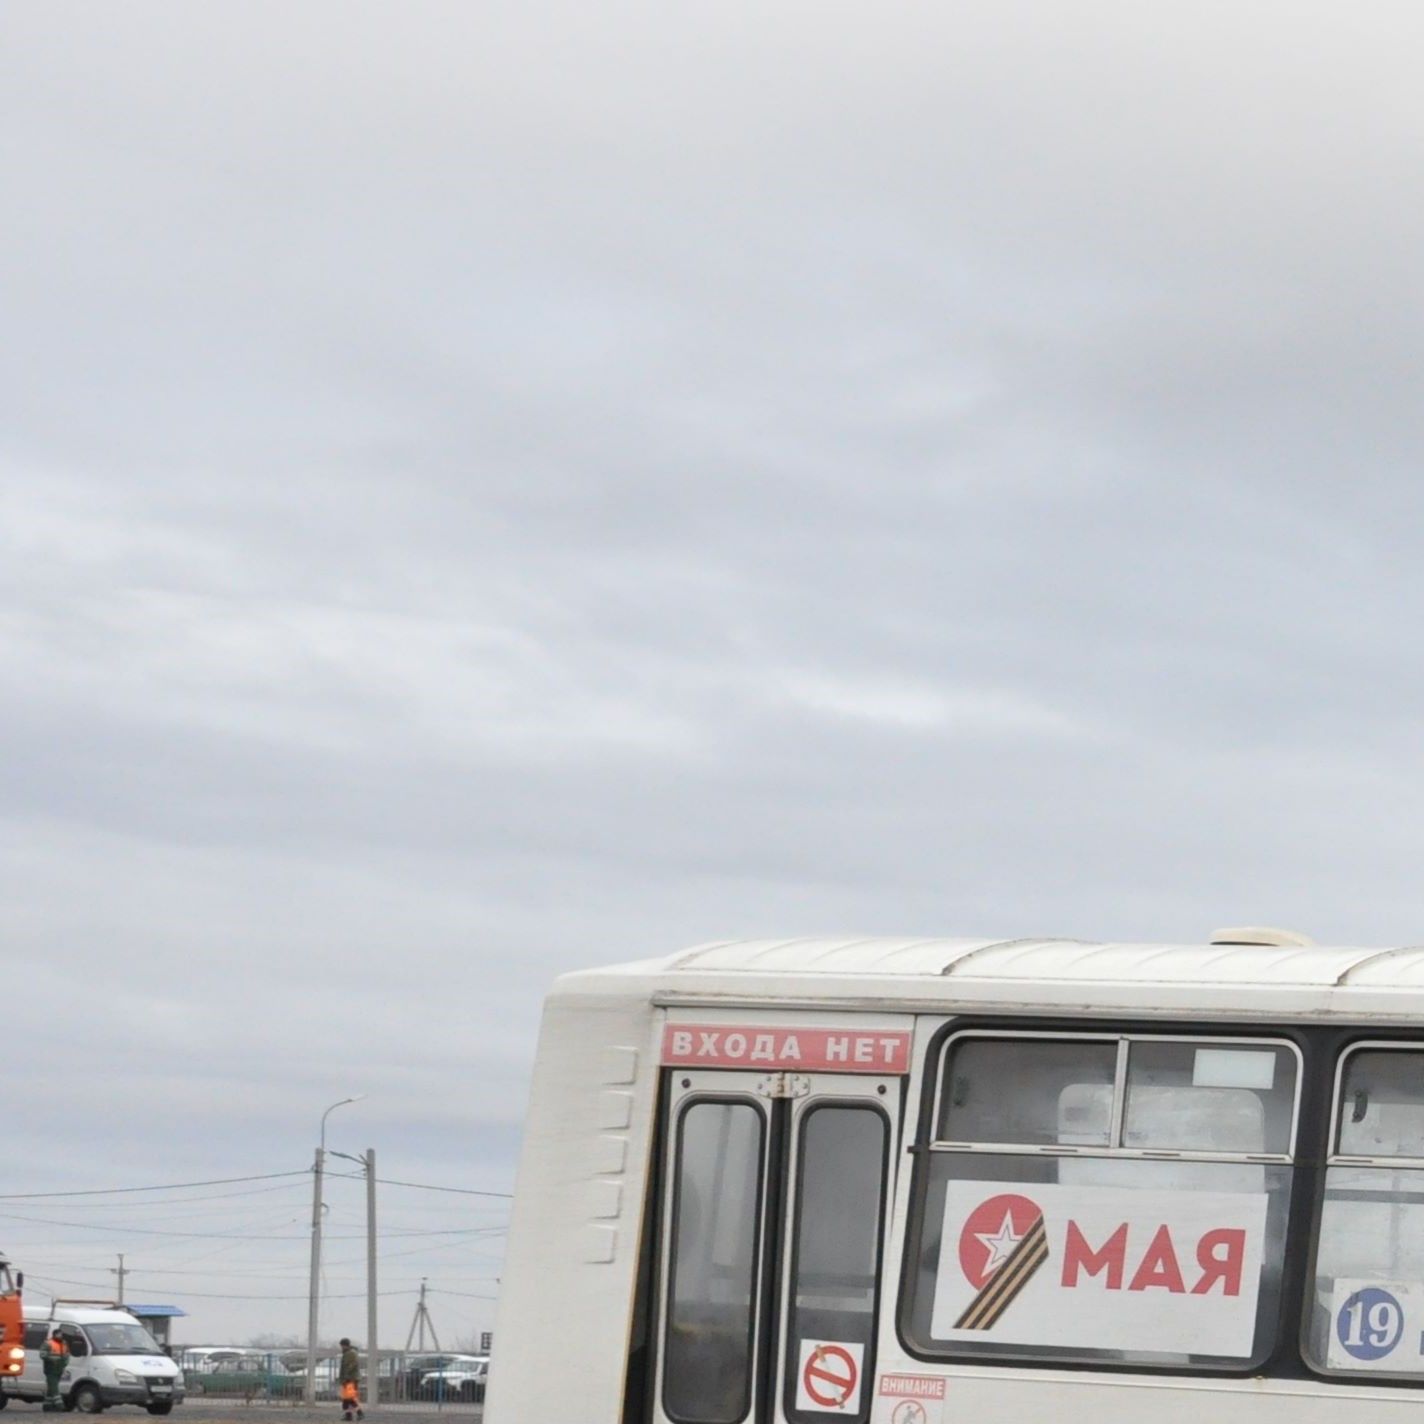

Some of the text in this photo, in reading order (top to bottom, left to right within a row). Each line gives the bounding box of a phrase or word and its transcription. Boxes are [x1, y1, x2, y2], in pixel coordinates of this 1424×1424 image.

[671, 1031, 901, 1064] ВХОДА НЕТ
[1060, 1218, 1247, 1297] МАЯ
[1343, 1301, 1400, 1349] 19
[880, 1377, 944, 1396] ВНИМАНИЕ
